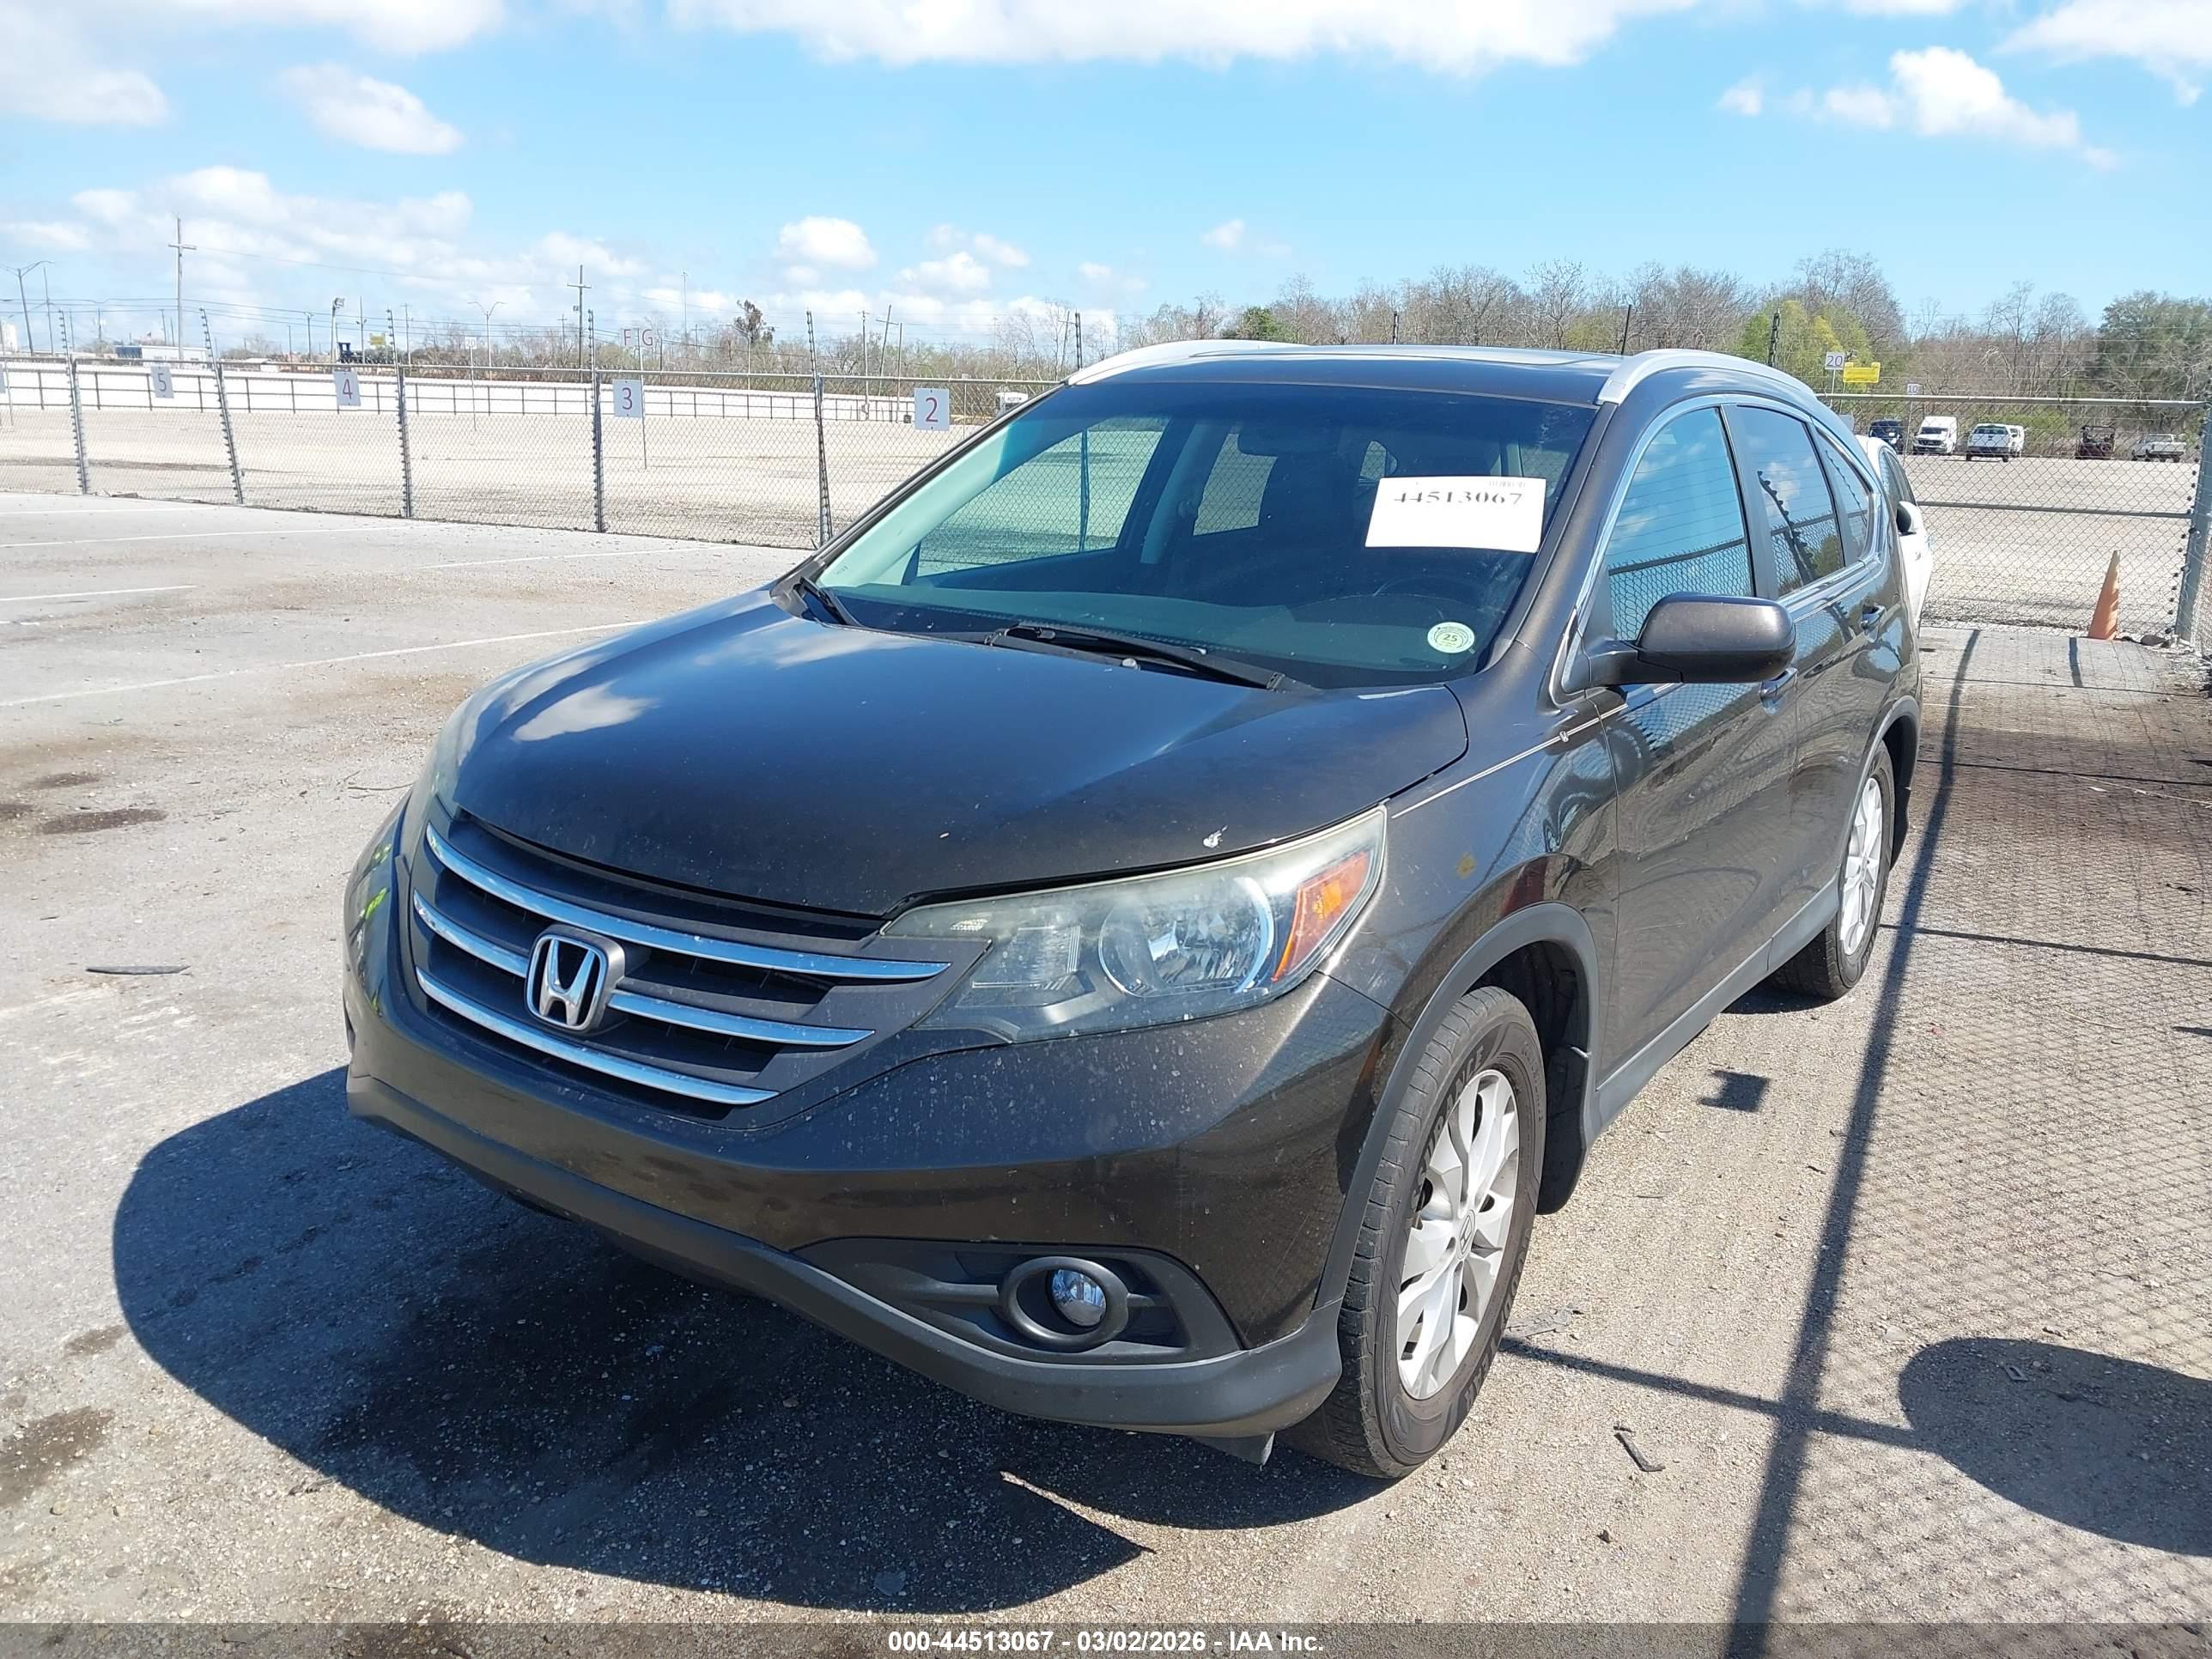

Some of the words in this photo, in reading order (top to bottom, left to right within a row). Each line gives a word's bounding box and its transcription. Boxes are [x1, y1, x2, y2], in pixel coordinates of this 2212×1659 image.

[623, 329, 631, 346] F
[641, 329, 653, 347] G
[1826, 356, 1843, 367] 20
[157, 373, 167, 392] 5
[342, 379, 354, 399] 4
[621, 387, 633, 410] 3
[925, 397, 939, 422] 2
[1394, 491, 1522, 505] 44513067
[1443, 633, 1458, 642] 25
